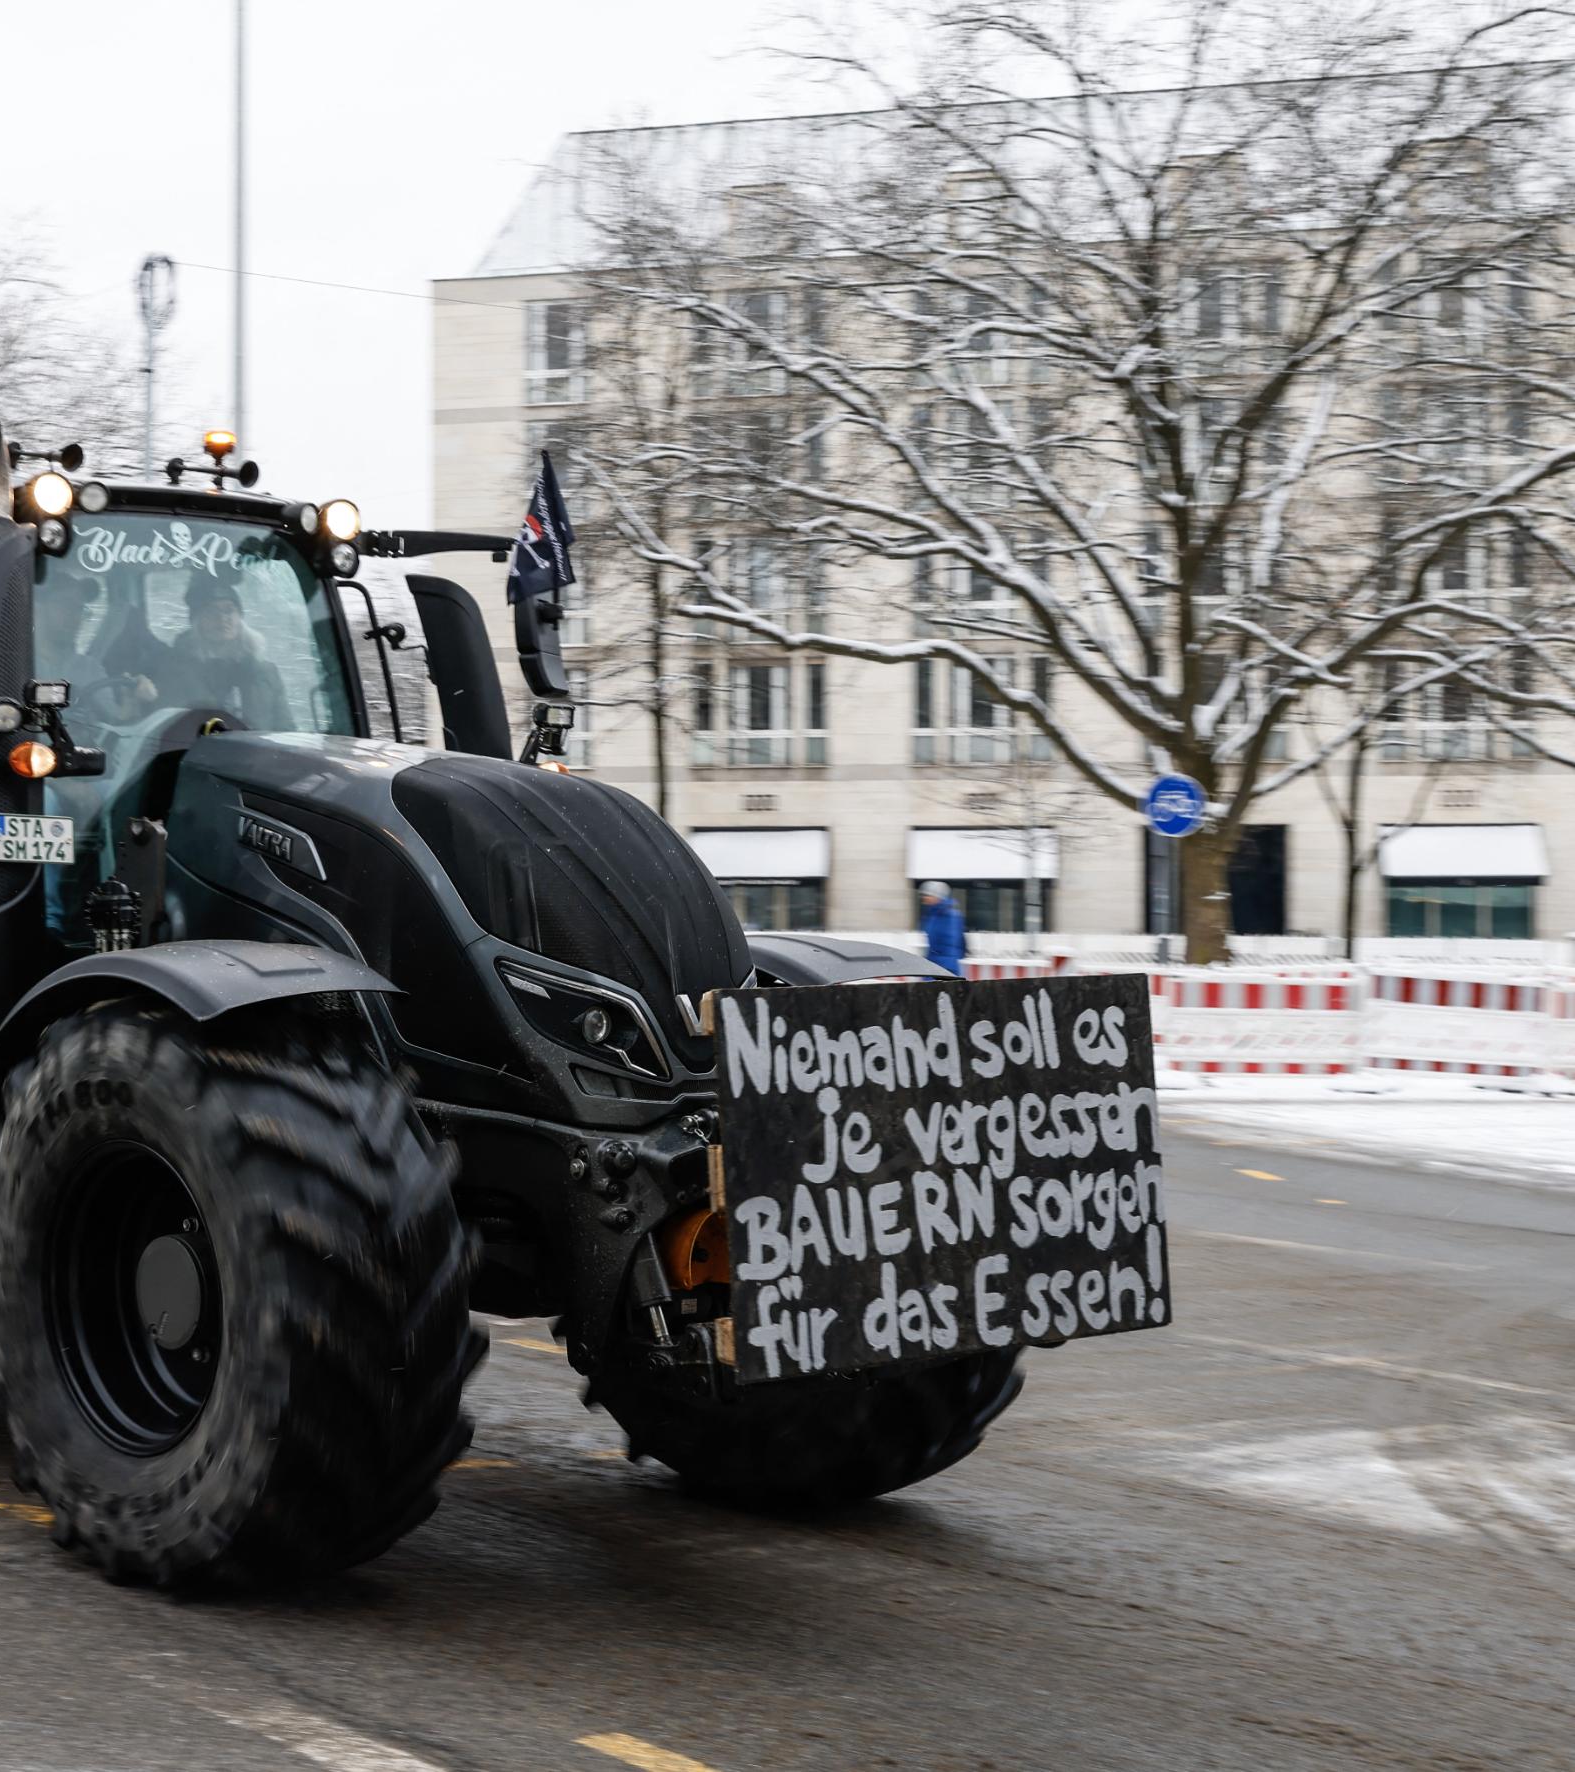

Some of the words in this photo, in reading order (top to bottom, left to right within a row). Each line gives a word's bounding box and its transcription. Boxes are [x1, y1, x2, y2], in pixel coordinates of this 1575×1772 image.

[72, 526, 168, 573] Black
[3, 840, 27, 860] SM
[32, 841, 66, 861] 174
[8, 818, 44, 838] STA
[238, 815, 292, 862] VALTRA
[721, 991, 963, 1098] Niemand
[970, 988, 1060, 1079] soll
[1073, 1005, 1129, 1068] es
[802, 1087, 883, 1184] je
[903, 1082, 1161, 1180] vergessen
[736, 1165, 996, 1281] BAUERN
[1009, 1159, 1166, 1251] sorgen
[748, 1275, 838, 1379] für
[863, 1263, 958, 1359] das
[974, 1224, 1166, 1347] Essen!
